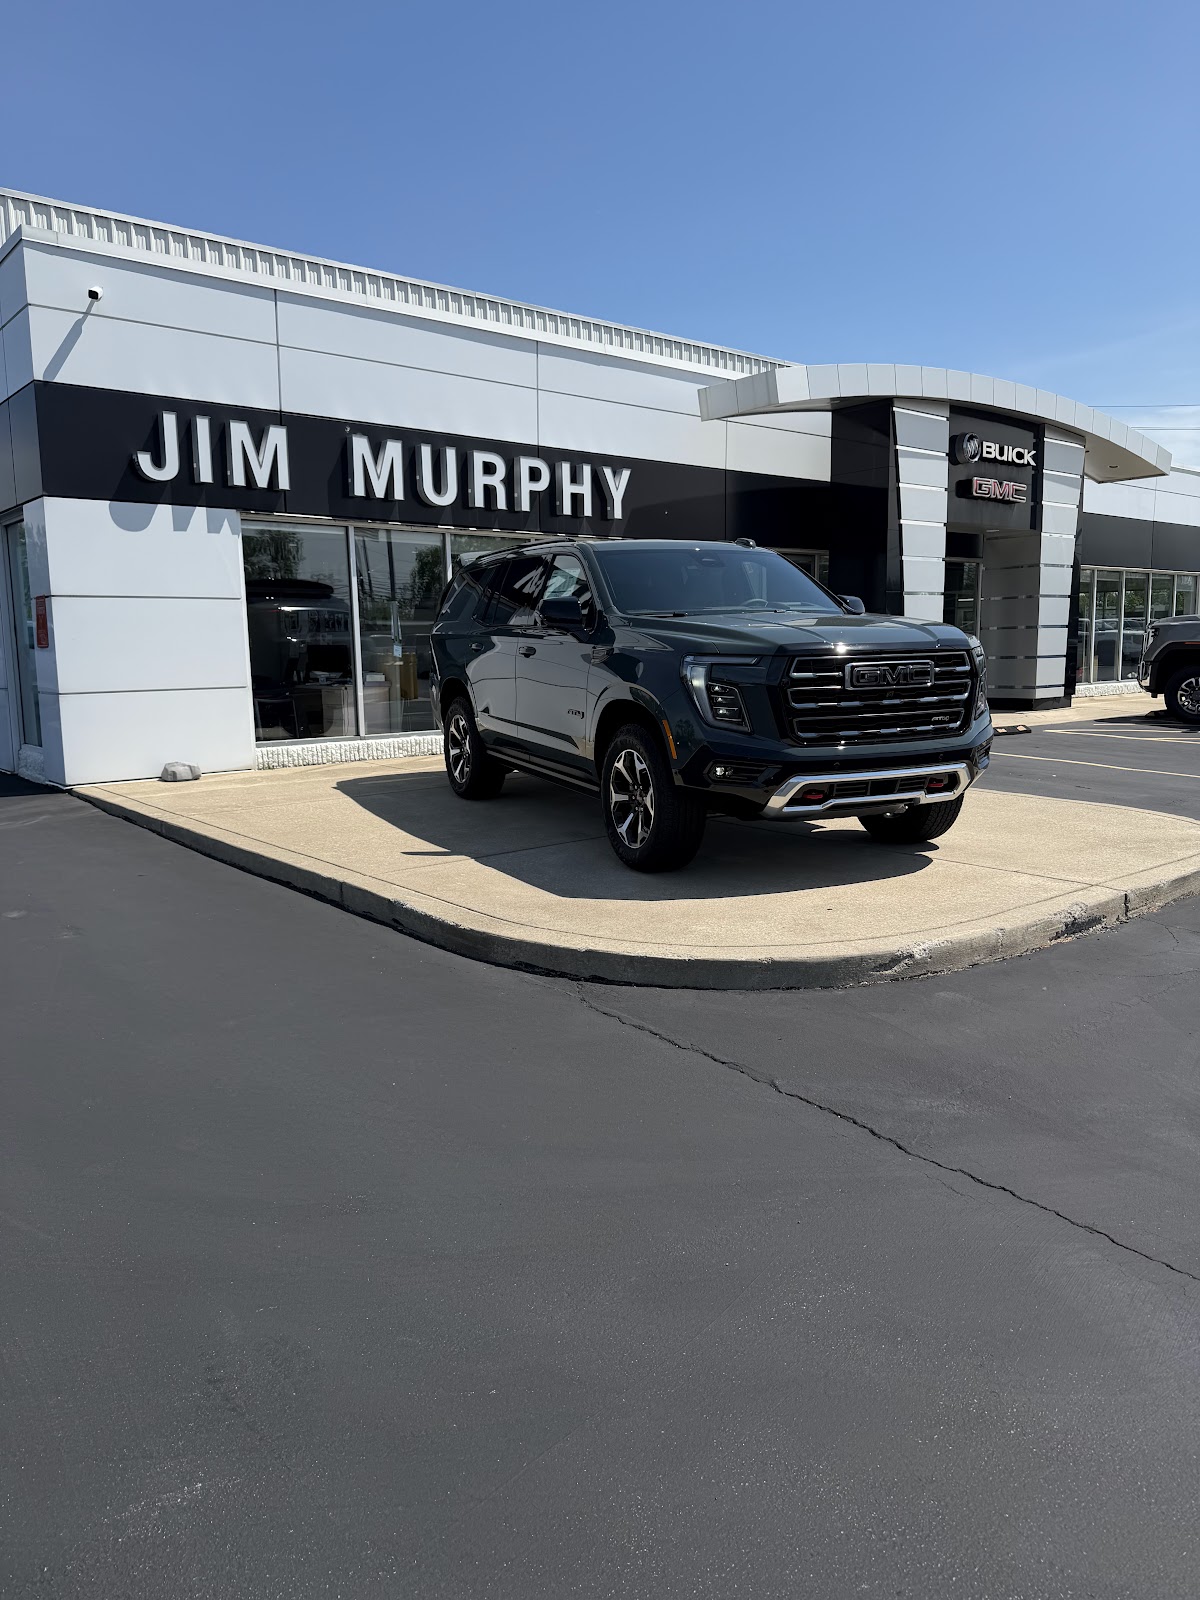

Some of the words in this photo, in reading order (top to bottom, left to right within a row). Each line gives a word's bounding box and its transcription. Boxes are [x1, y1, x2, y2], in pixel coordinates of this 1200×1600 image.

[134, 411, 290, 490] JIM
[348, 433, 632, 519] MURPHY
[982, 441, 1036, 466] BUICK
[972, 477, 1027, 503] GMC
[853, 666, 931, 686] GMC
